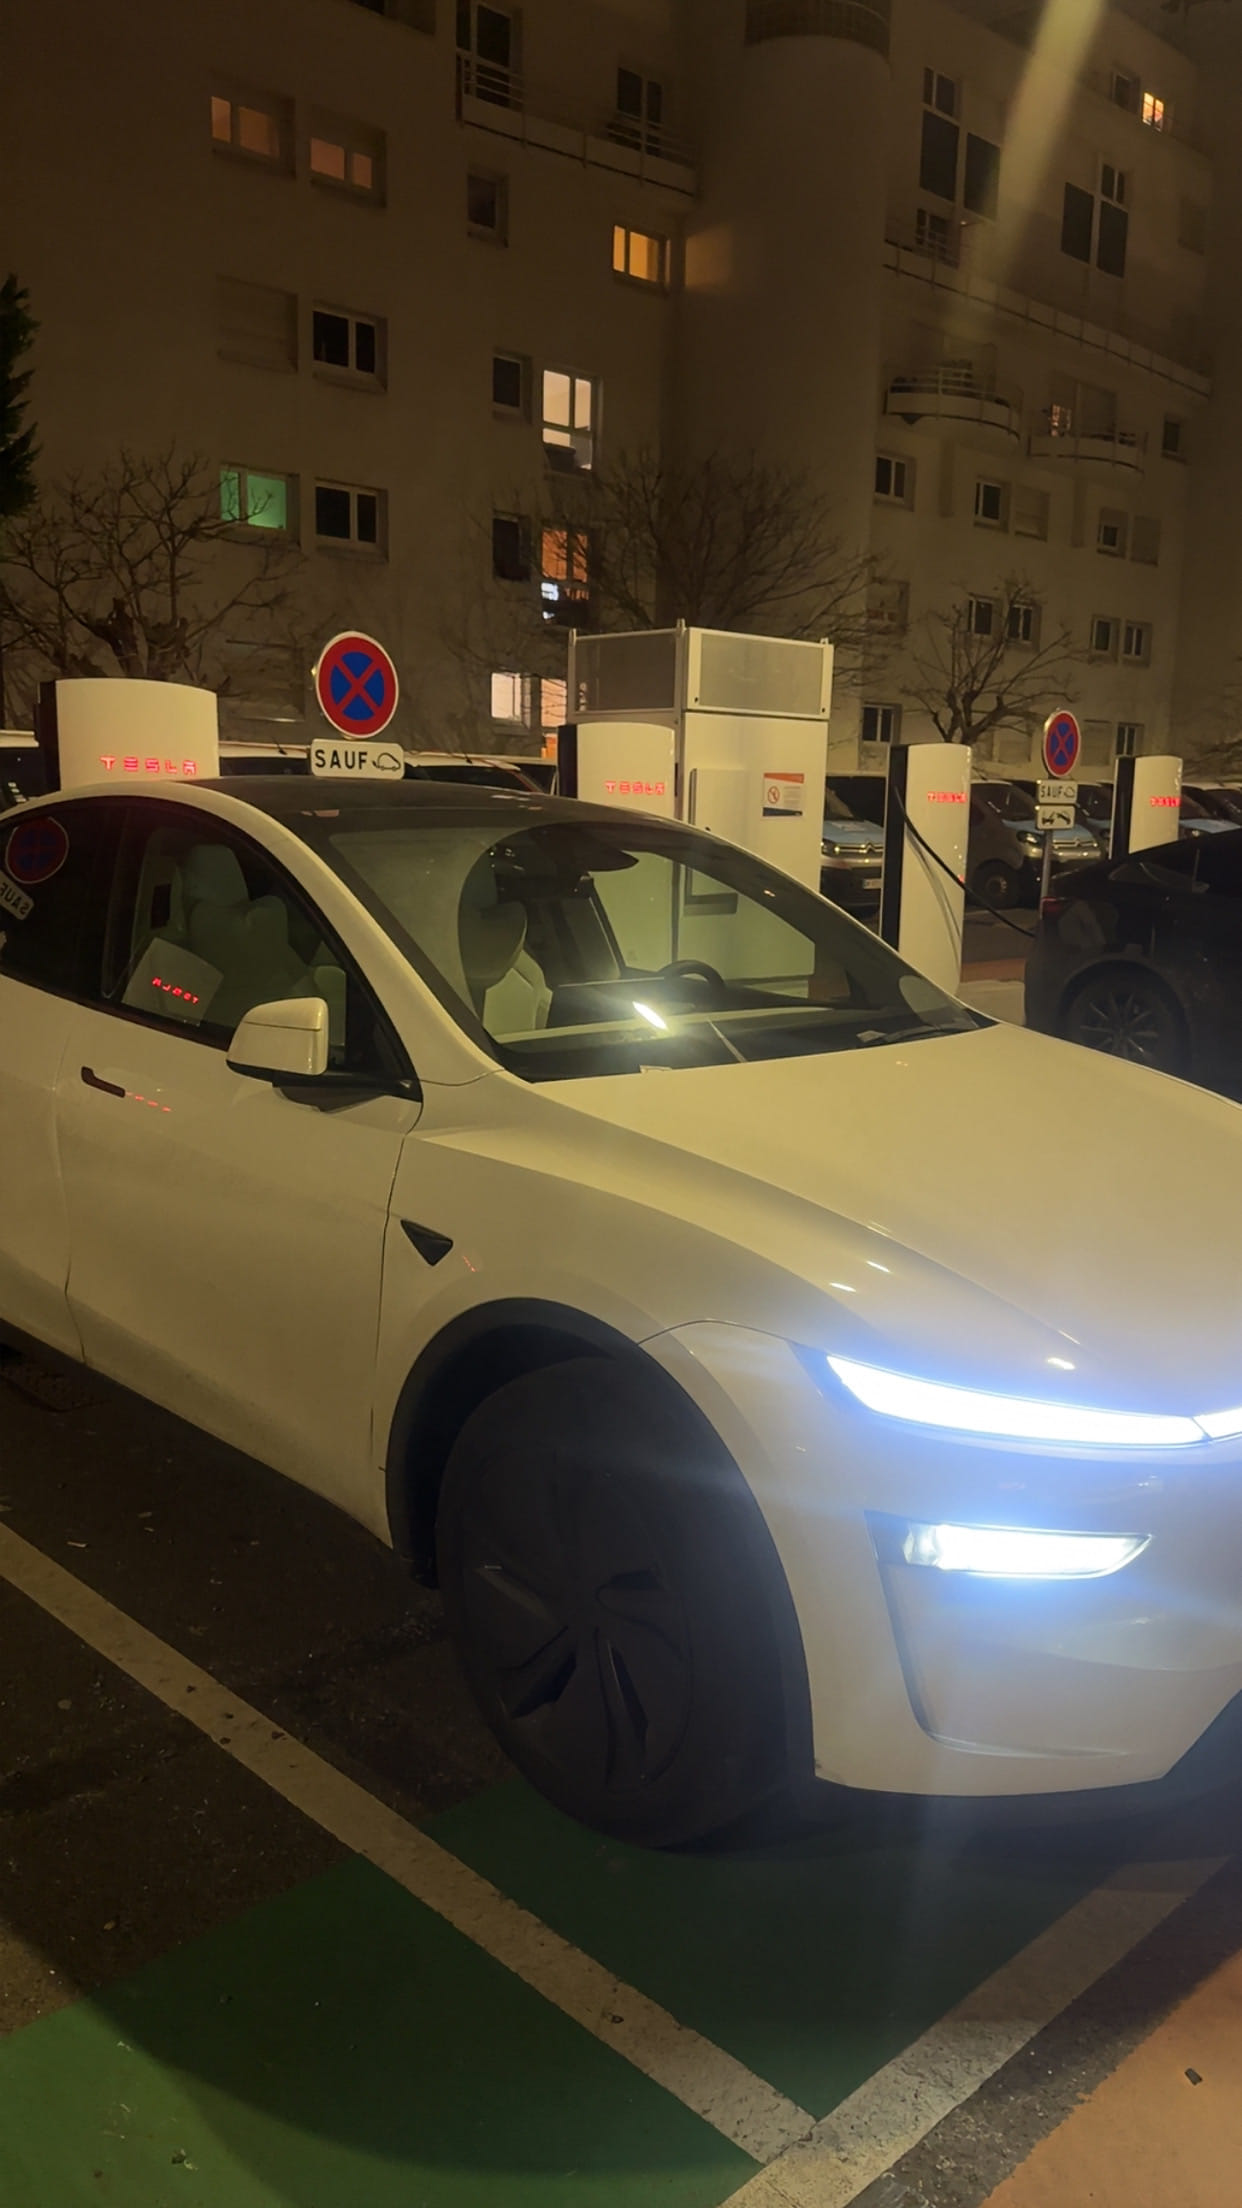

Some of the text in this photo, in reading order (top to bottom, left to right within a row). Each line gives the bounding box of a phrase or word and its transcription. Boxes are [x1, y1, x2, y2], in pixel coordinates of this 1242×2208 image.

[99, 756, 197, 775] TESLA
[315, 749, 368, 770] SAUF
[604, 780, 665, 796] TESLA
